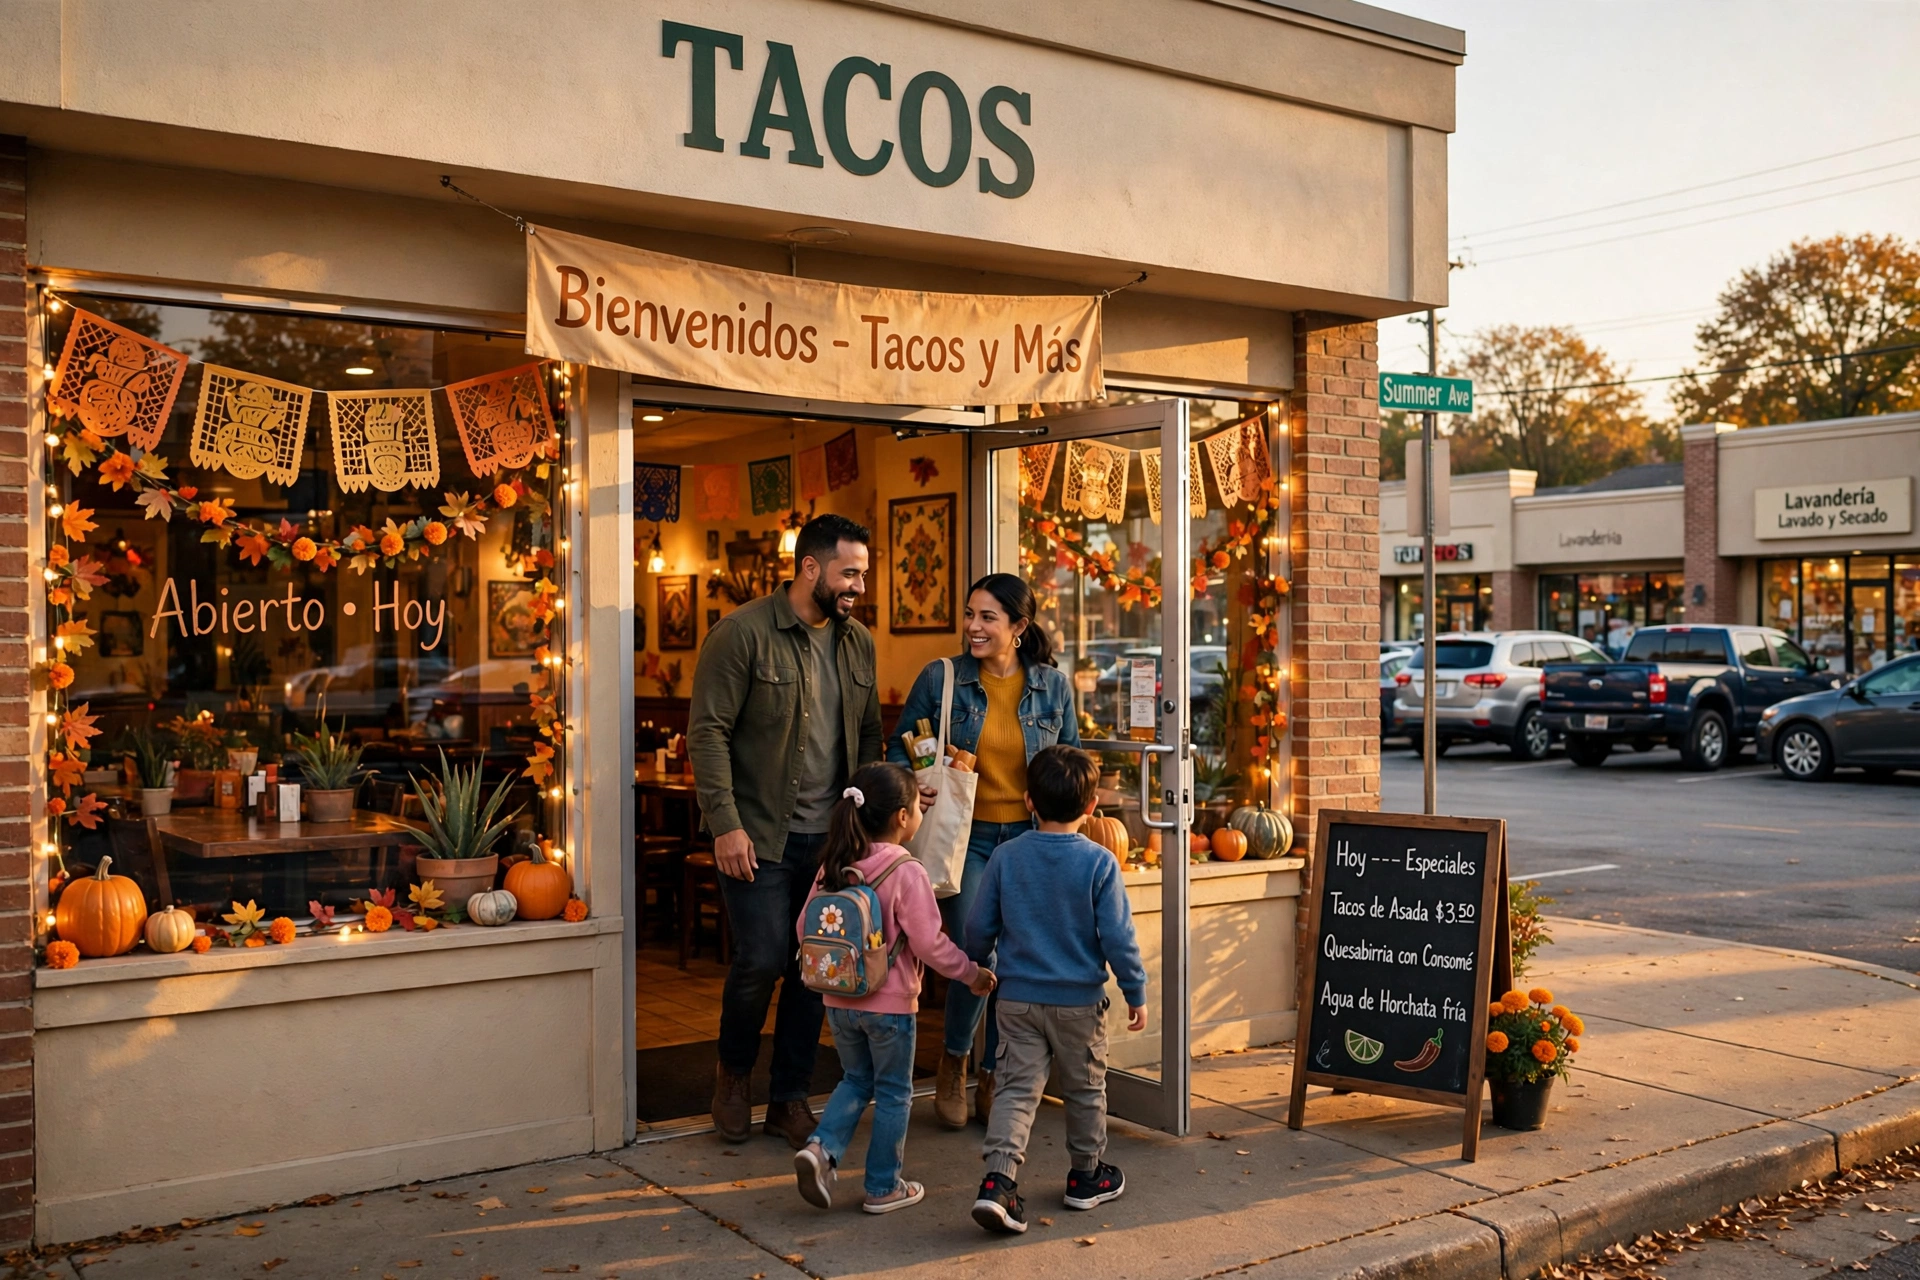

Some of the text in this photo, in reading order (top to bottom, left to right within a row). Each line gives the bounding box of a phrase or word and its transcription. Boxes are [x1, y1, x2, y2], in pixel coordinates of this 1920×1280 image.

[661, 19, 1035, 199] TACOS
[555, 264, 818, 363] Bienvenidos
[861, 314, 965, 373] Tacos
[978, 338, 999, 388] y
[1013, 323, 1082, 374] Más
[1383, 376, 1469, 407] Summer Ave
[1785, 486, 1875, 509] Lavandería
[1778, 507, 1888, 529] Lavado y Secado
[150, 577, 325, 639] Abierto
[372, 579, 446, 651] Hoy
[1336, 840, 1367, 877] Hoy
[1406, 848, 1476, 879] Especiales
[1330, 891, 1475, 924] Tacos de Asada $3.50
[1324, 933, 1474, 972] Quesabirria con Consomé
[1320, 981, 1467, 1023] Agua de Horchata fría
